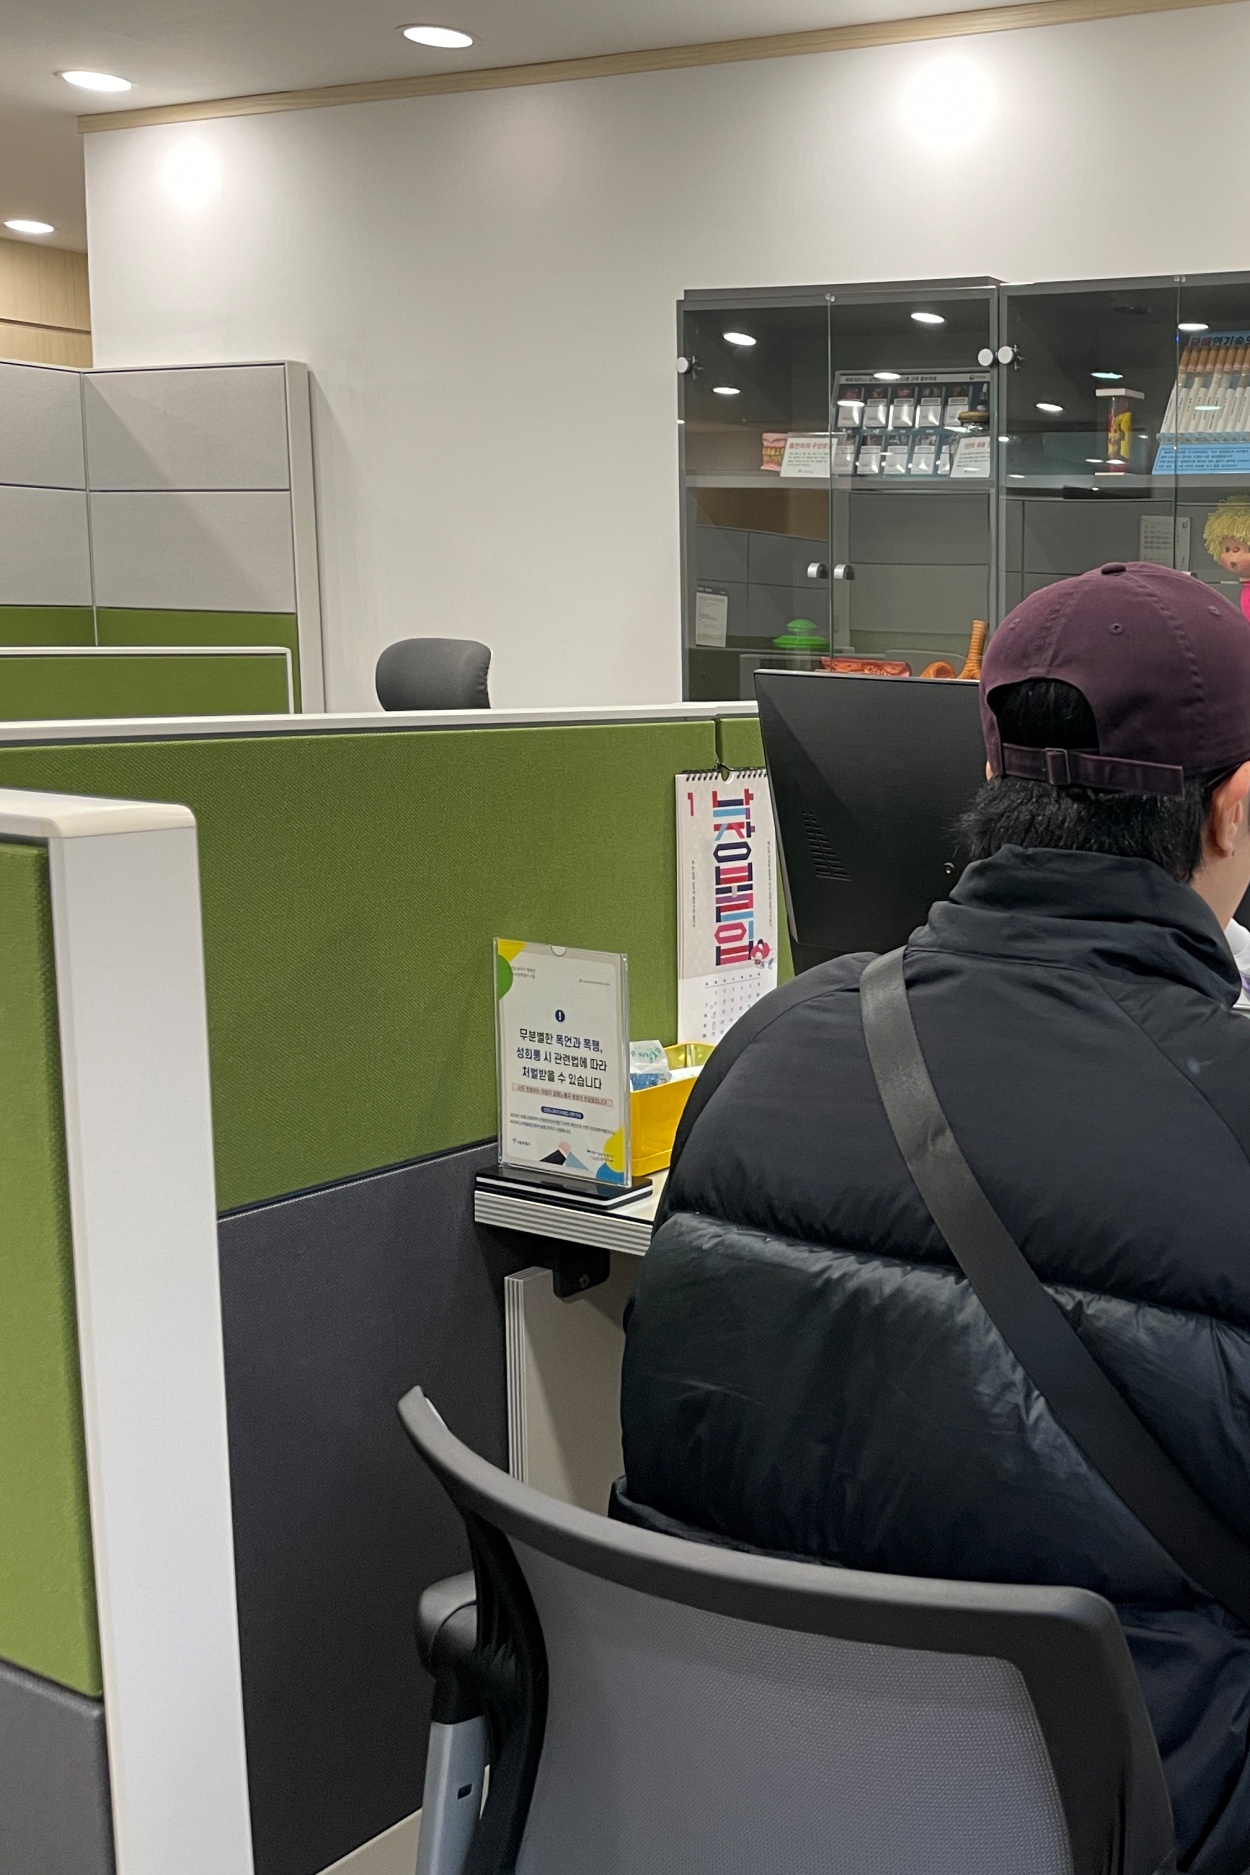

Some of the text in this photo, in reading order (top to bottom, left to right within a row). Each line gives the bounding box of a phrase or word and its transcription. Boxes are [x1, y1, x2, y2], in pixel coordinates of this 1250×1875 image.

[519, 1028, 603, 1054] 무분별한 폭언과 폭행,
[516, 1047, 608, 1072] 성희롱 시 관련법에 따라
[522, 1066, 602, 1090] 처벌받을 수 있습니다
